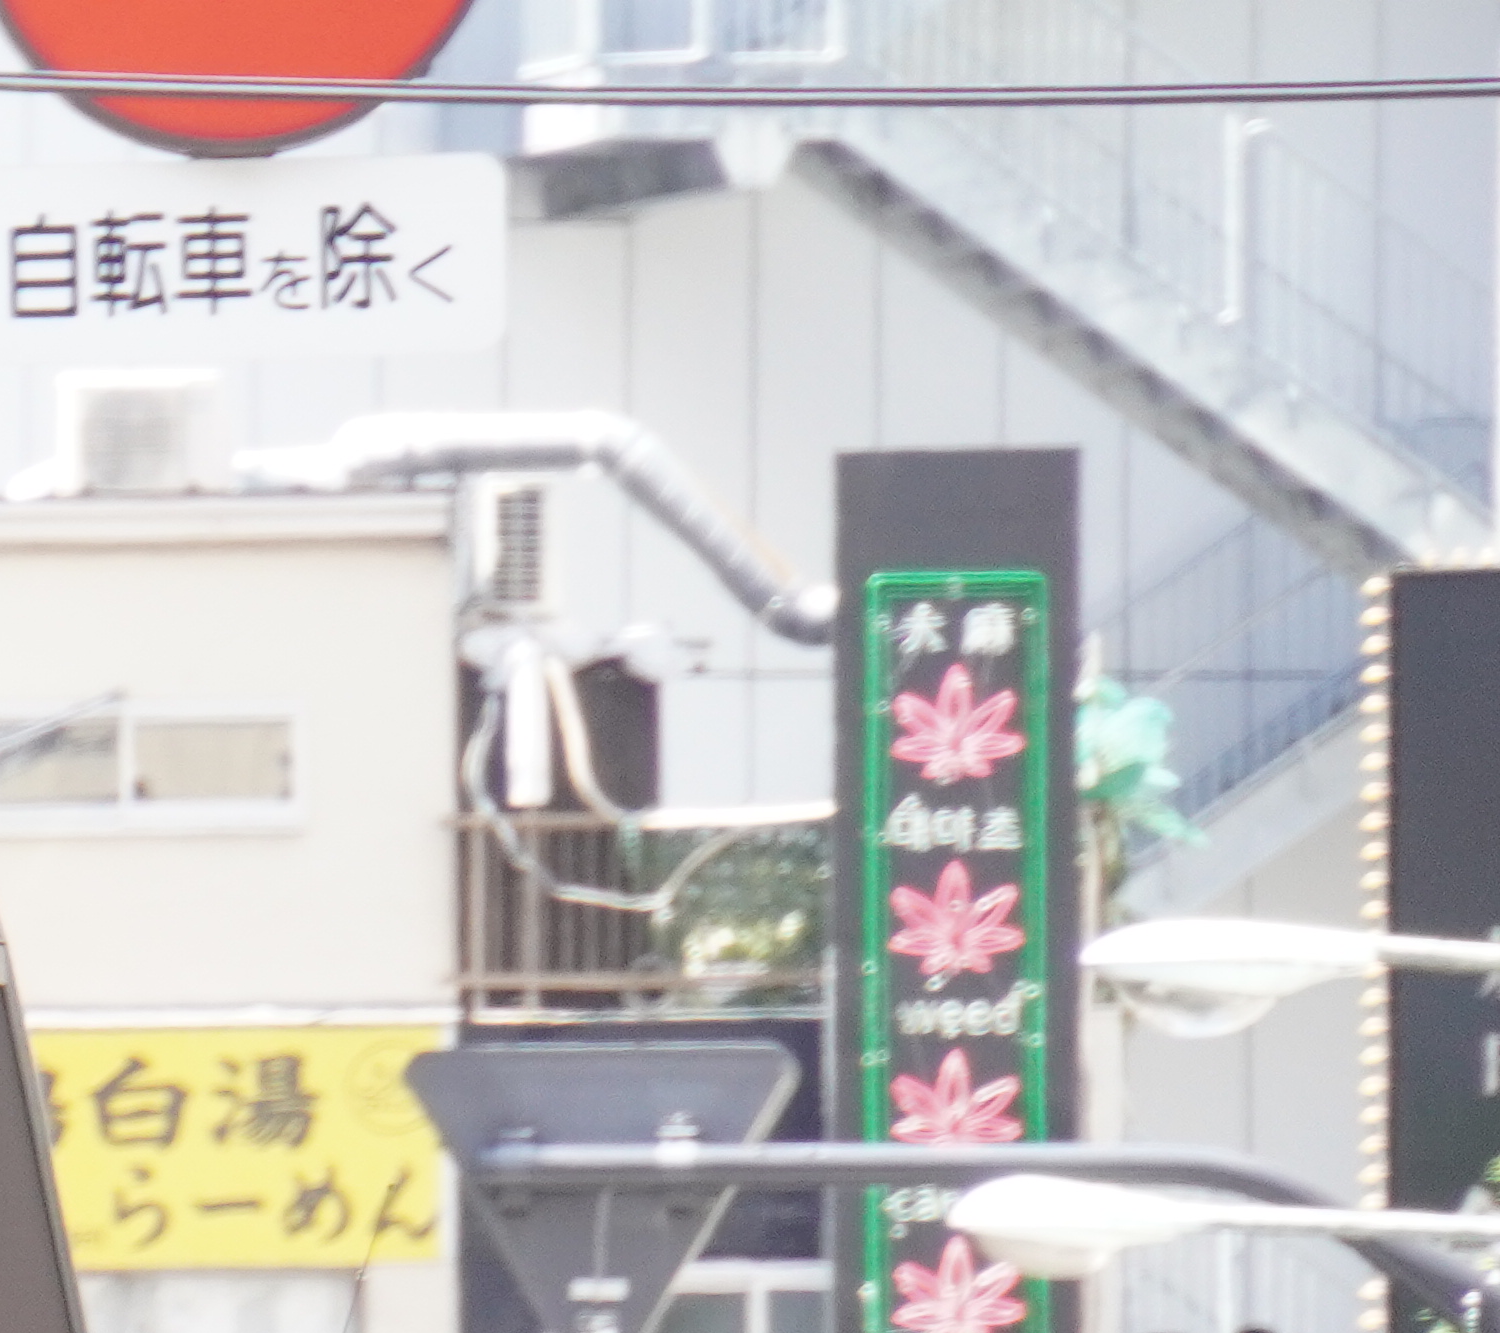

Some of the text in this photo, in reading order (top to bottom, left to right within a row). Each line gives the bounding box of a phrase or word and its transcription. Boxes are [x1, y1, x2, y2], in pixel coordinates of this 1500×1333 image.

[8, 202, 456, 319] 自転車を除く
[897, 982, 1021, 1037] weed
[43, 1052, 320, 1150] 白湯
[111, 1167, 440, 1249] らーめん
